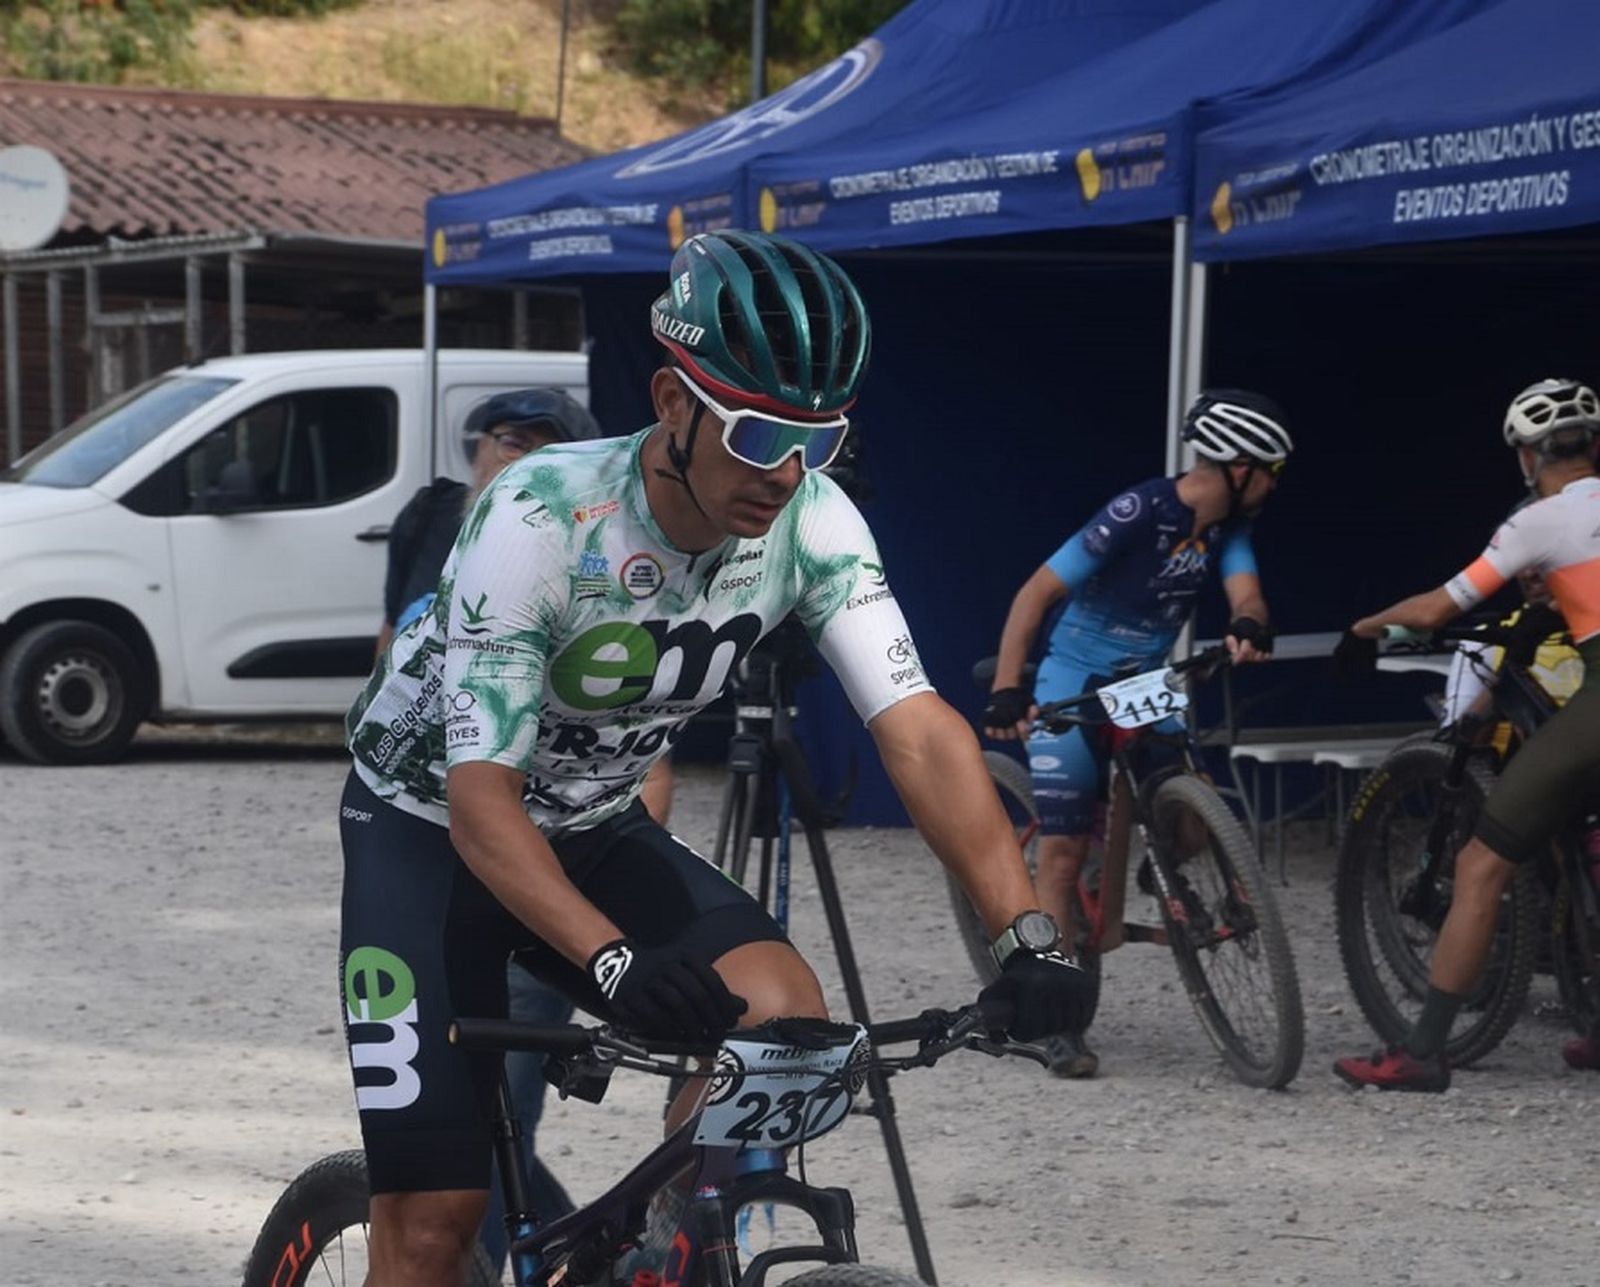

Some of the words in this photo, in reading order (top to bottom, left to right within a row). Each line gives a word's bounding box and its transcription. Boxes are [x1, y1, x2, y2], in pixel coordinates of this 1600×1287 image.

[1309, 136, 1431, 185] CRONOMETRAJE
[1432, 112, 1553, 168] ORGANIZACIÓN
[1554, 115, 1567, 151] Y
[1394, 184, 1464, 222] EVENTOS
[1466, 170, 1570, 217] DEPORTIVOS
[549, 612, 763, 711] em
[1124, 691, 1179, 722] 112
[724, 1085, 846, 1141] 237
